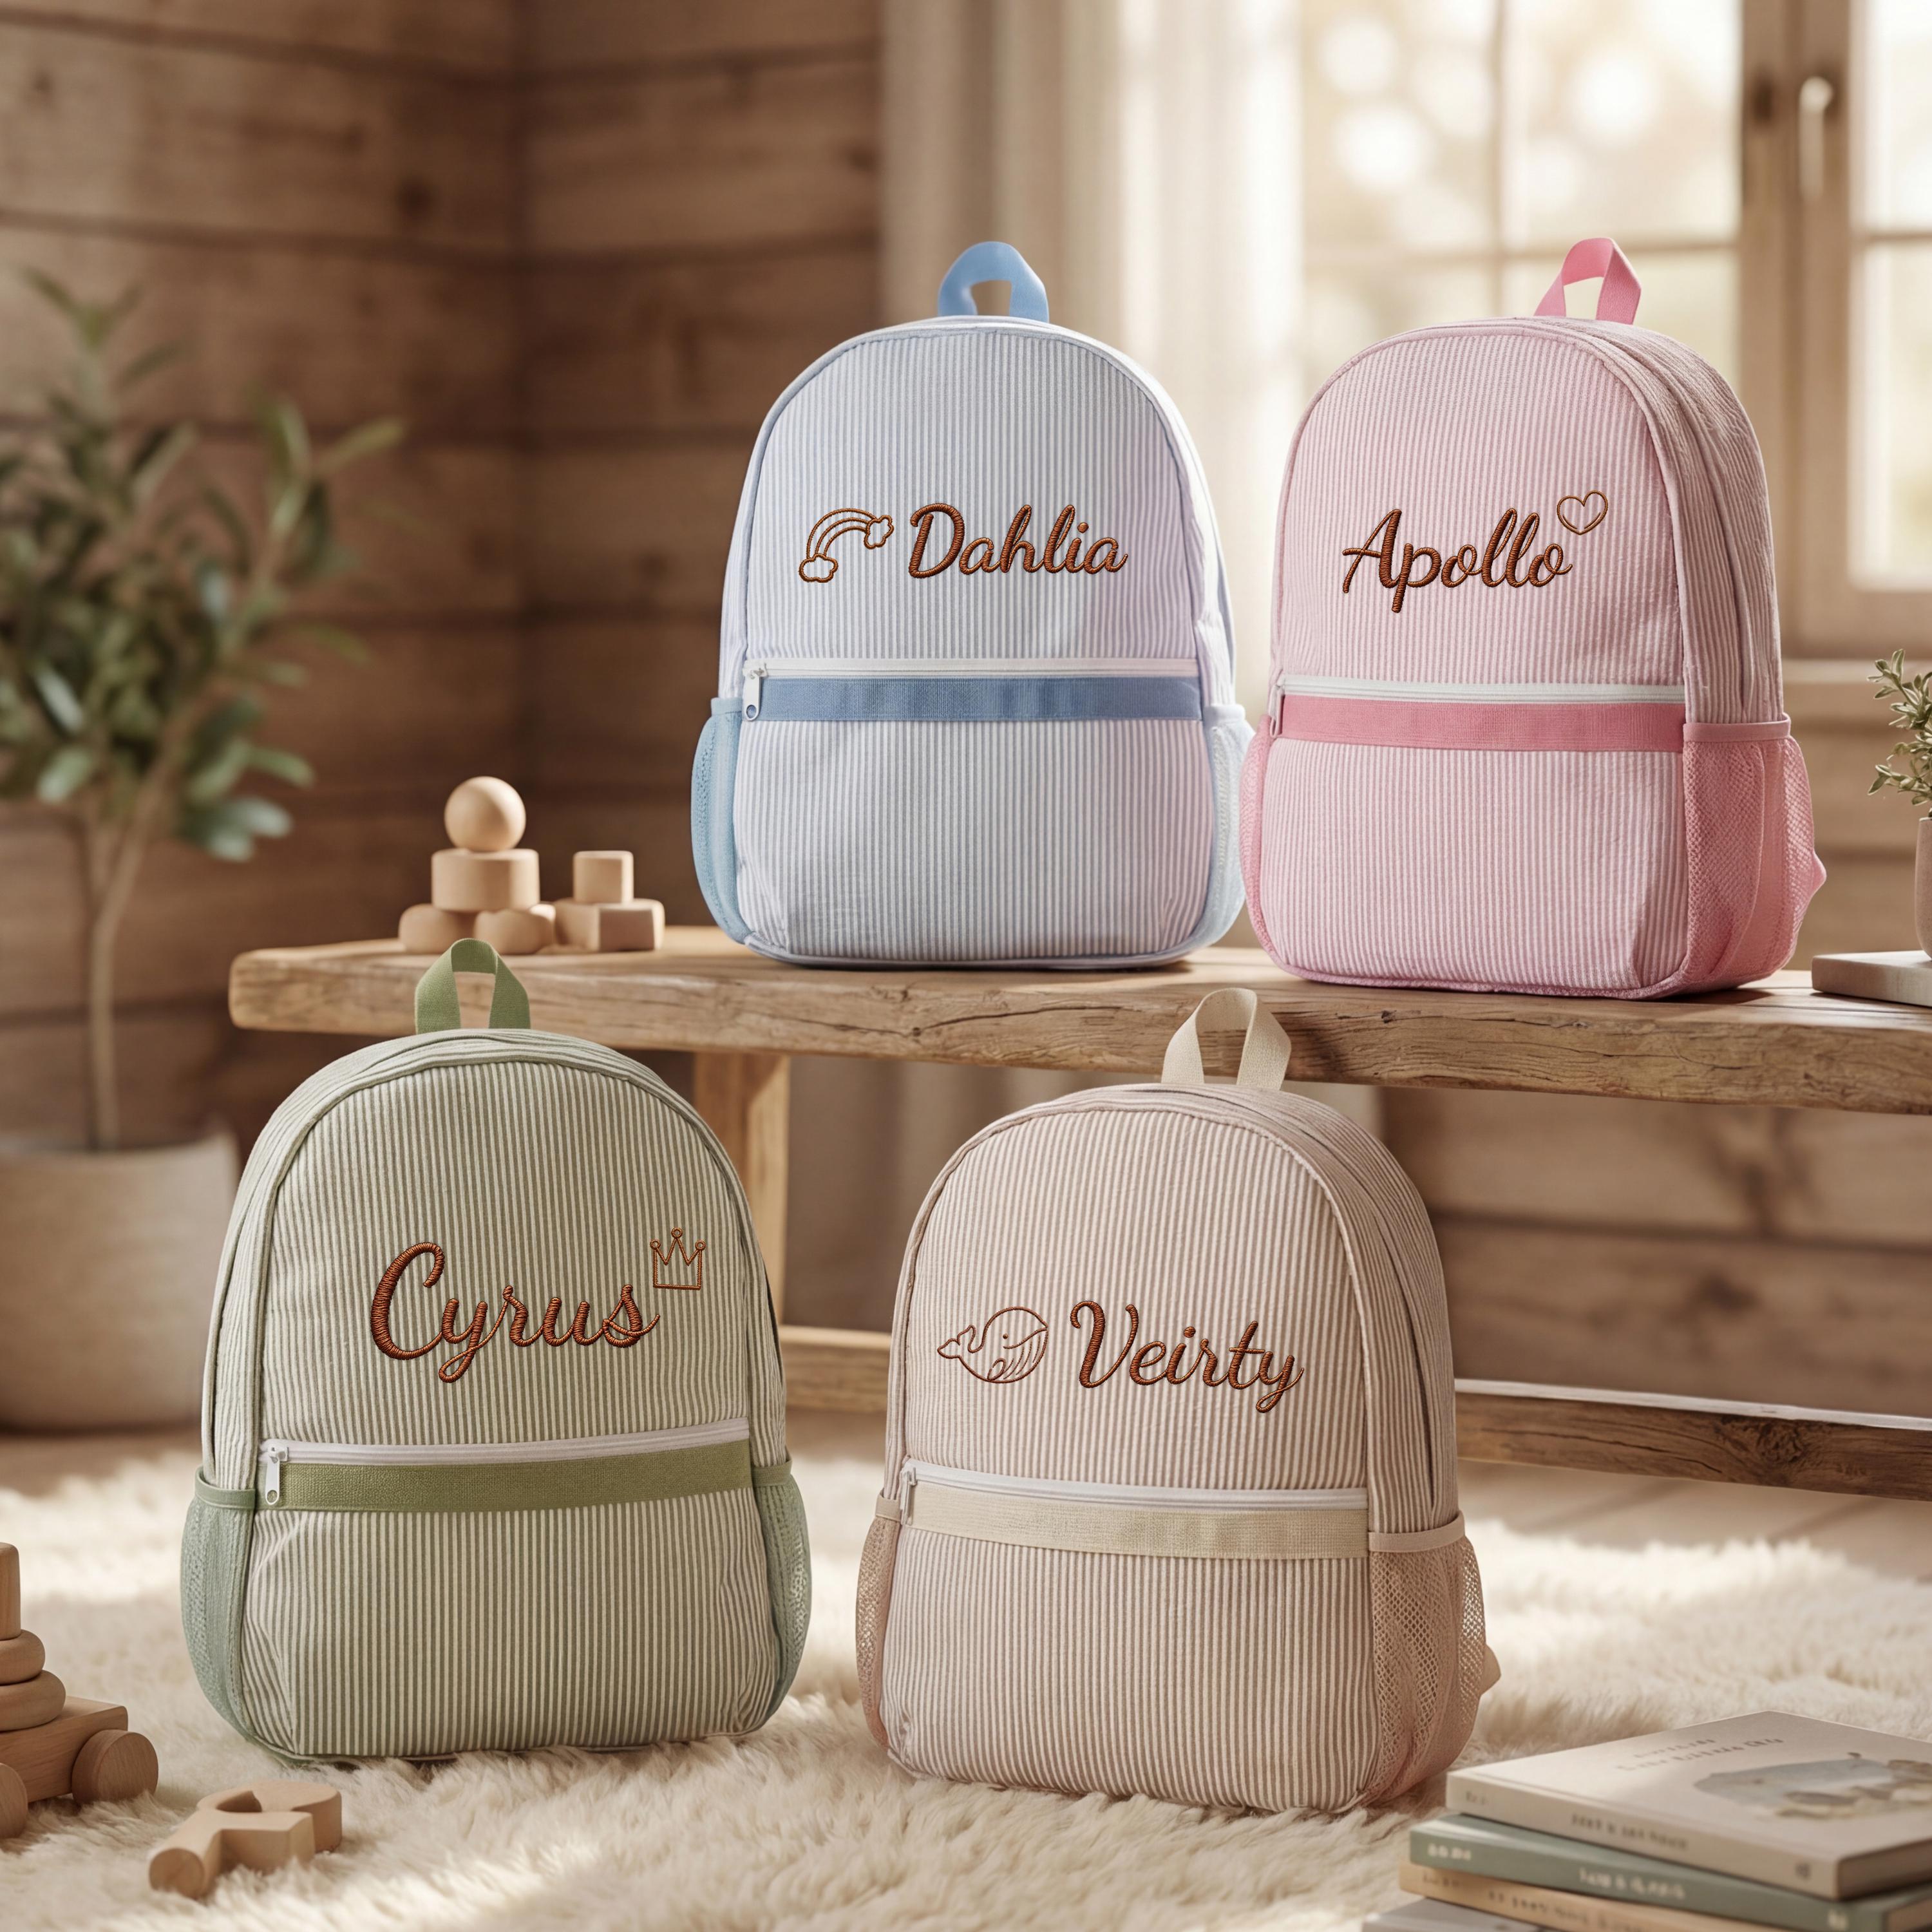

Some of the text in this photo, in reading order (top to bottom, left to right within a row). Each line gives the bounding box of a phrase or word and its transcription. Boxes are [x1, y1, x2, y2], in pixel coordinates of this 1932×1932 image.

[908, 502, 1128, 579] Dahlia
[1342, 507, 1573, 613] Apollo
[370, 1242, 660, 1383] Cyrus
[1070, 1300, 1304, 1413] Veirty
